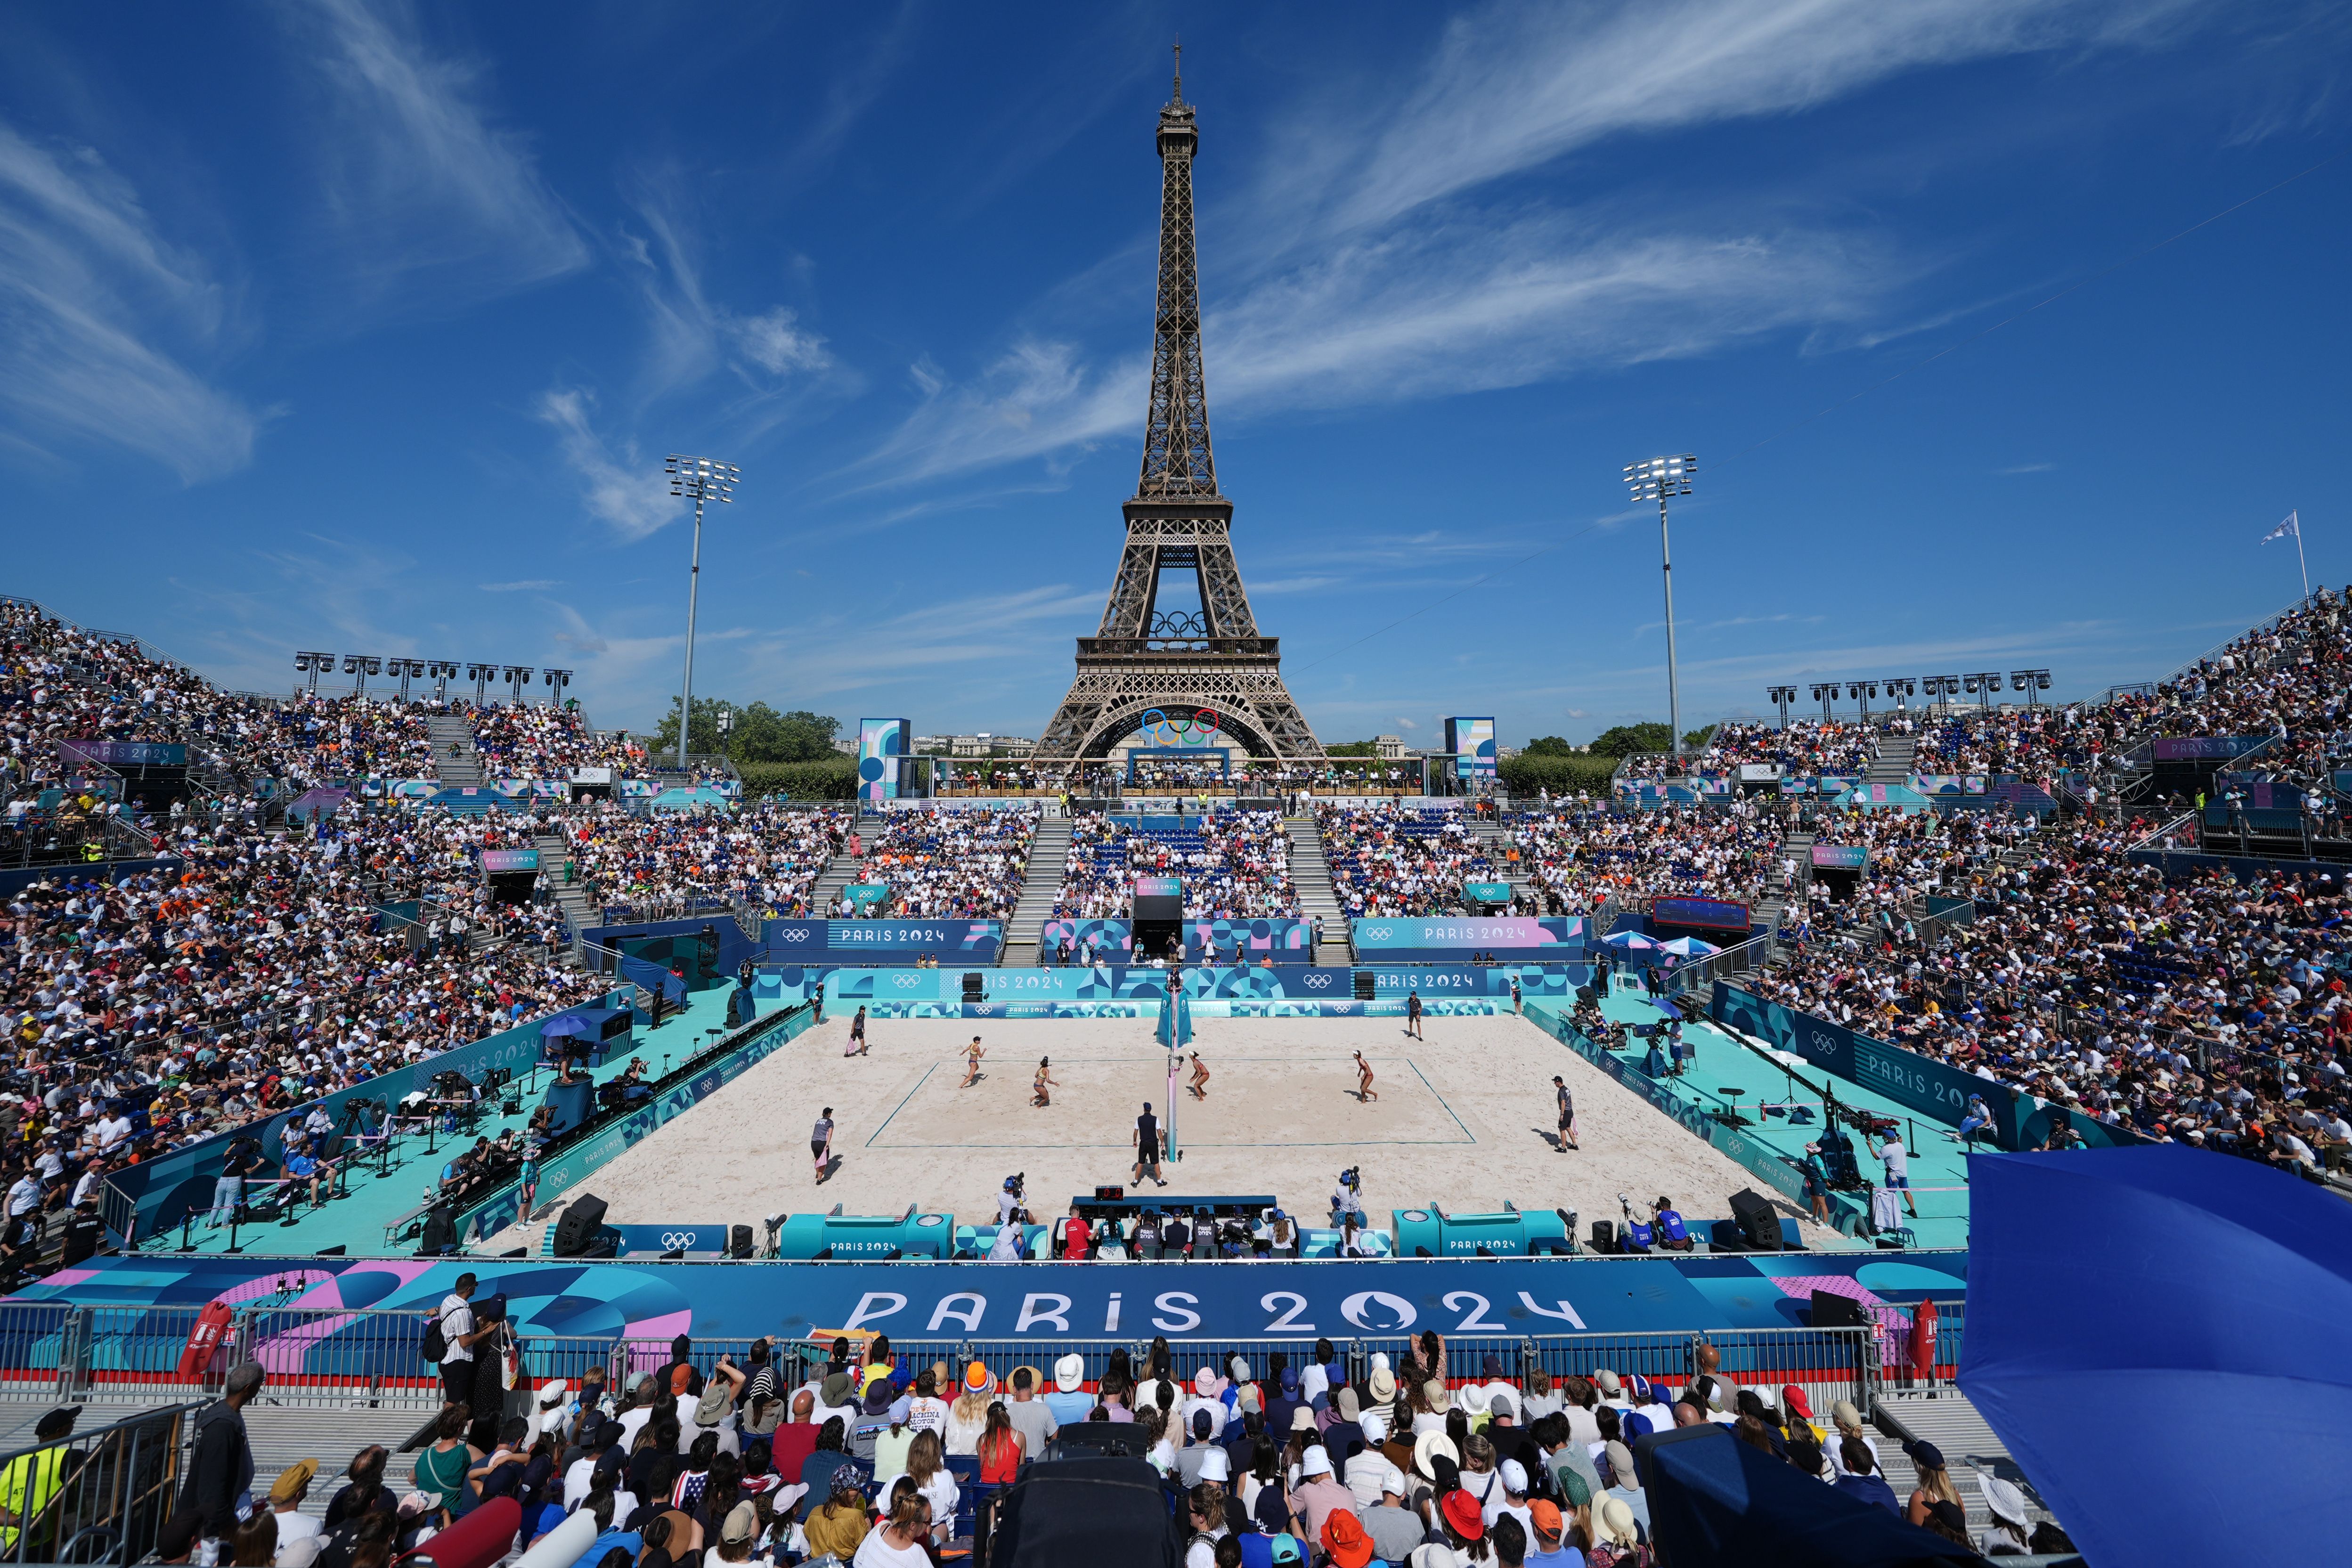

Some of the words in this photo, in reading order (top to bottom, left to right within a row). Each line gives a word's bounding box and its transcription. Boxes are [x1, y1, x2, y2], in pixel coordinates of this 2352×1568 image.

[132, 748, 169, 758] 2024
[899, 930, 944, 942] 2024
[1481, 927, 1525, 939] 2024
[1015, 976, 1062, 989] 2024
[1426, 974, 1473, 987] 2024
[494, 1037, 538, 1068] 2024
[734, 1060, 745, 1072] 2024
[1636, 1080, 1649, 1092] 2024
[1934, 1081, 1964, 1109] 20
[605, 1137, 621, 1153] 2024
[1779, 1172, 1798, 1190] 2024
[1690, 1232, 1705, 1243] 24
[867, 1242, 895, 1251] 2024
[1487, 1241, 1515, 1249] 2024
[1260, 1291, 1588, 1331] 2024
[857, 1432, 877, 1440] patago
